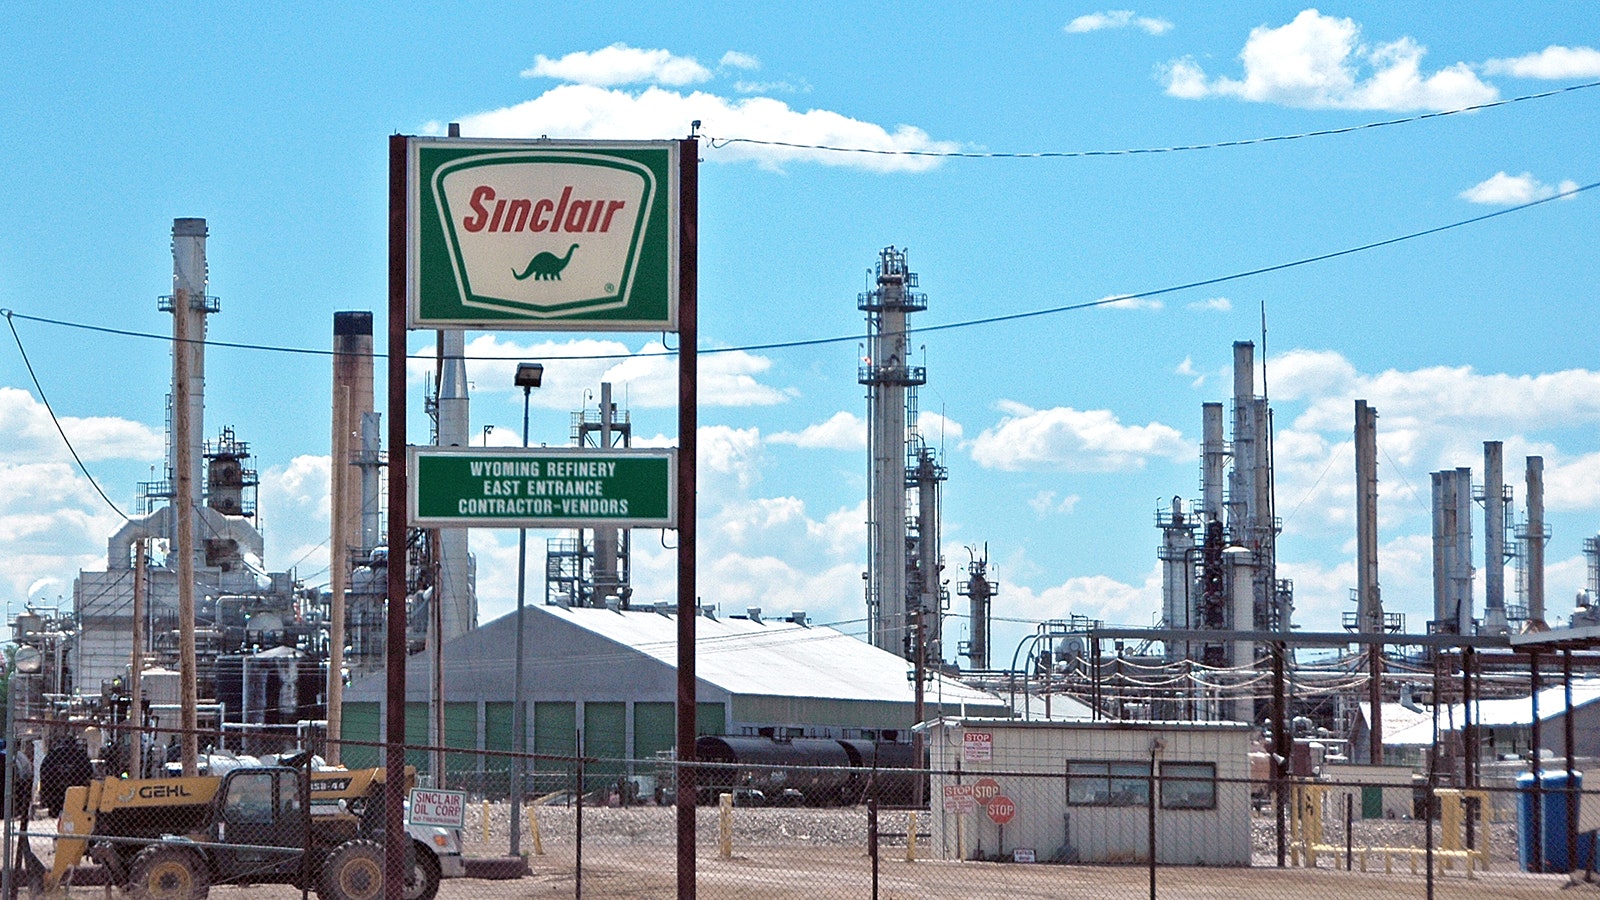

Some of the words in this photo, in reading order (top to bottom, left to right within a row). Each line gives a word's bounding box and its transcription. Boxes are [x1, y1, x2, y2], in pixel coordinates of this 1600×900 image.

[463, 185, 625, 233] Sinclair
[470, 461, 540, 477] WYOMING
[547, 462, 616, 477] REFINERY
[483, 480, 520, 496] EAST
[527, 481, 603, 496] ENTRANCE
[458, 498, 629, 515] CONTRACTOR-VENDORS
[966, 733, 990, 742] STOP
[139, 785, 191, 799] GEHL
[945, 786, 971, 796] STOP
[975, 785, 999, 798] STOP
[416, 792, 460, 805] SINCLAIR
[414, 803, 428, 815] OIL
[988, 804, 1014, 816] STOP
